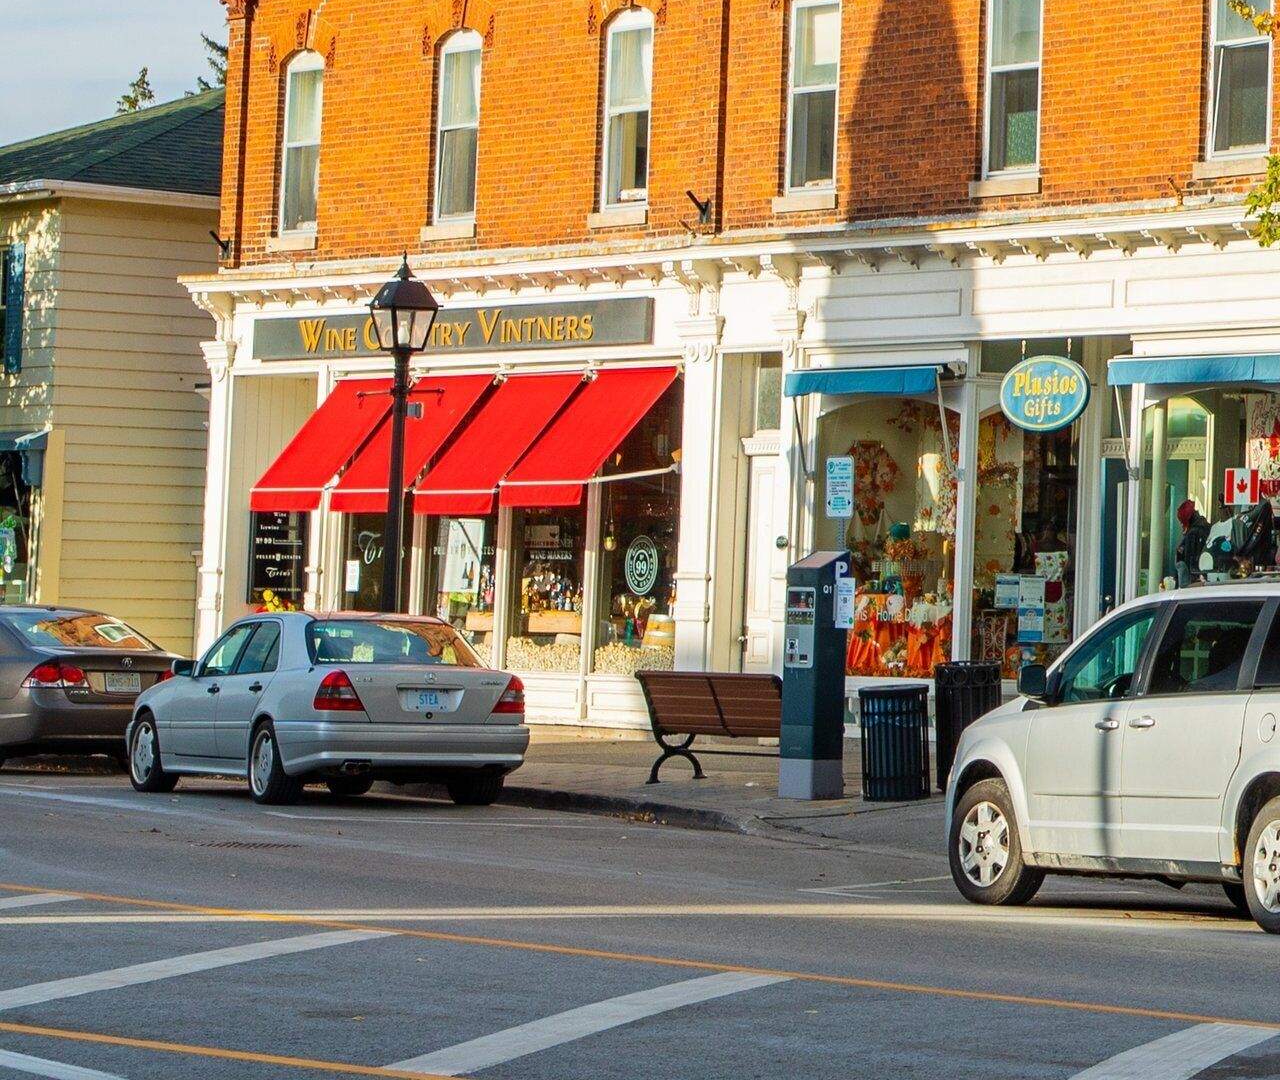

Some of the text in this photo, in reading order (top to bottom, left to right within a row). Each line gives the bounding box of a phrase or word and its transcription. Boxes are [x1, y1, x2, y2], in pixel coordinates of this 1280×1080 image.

[300, 319, 358, 353] WINE
[476, 309, 595, 344] VINTNERS
[1013, 367, 1078, 397] Plusios
[1024, 396, 1061, 423] Gifts
[635, 560, 647, 575] 99
[835, 561, 848, 581] P
[419, 694, 439, 706] STEA
